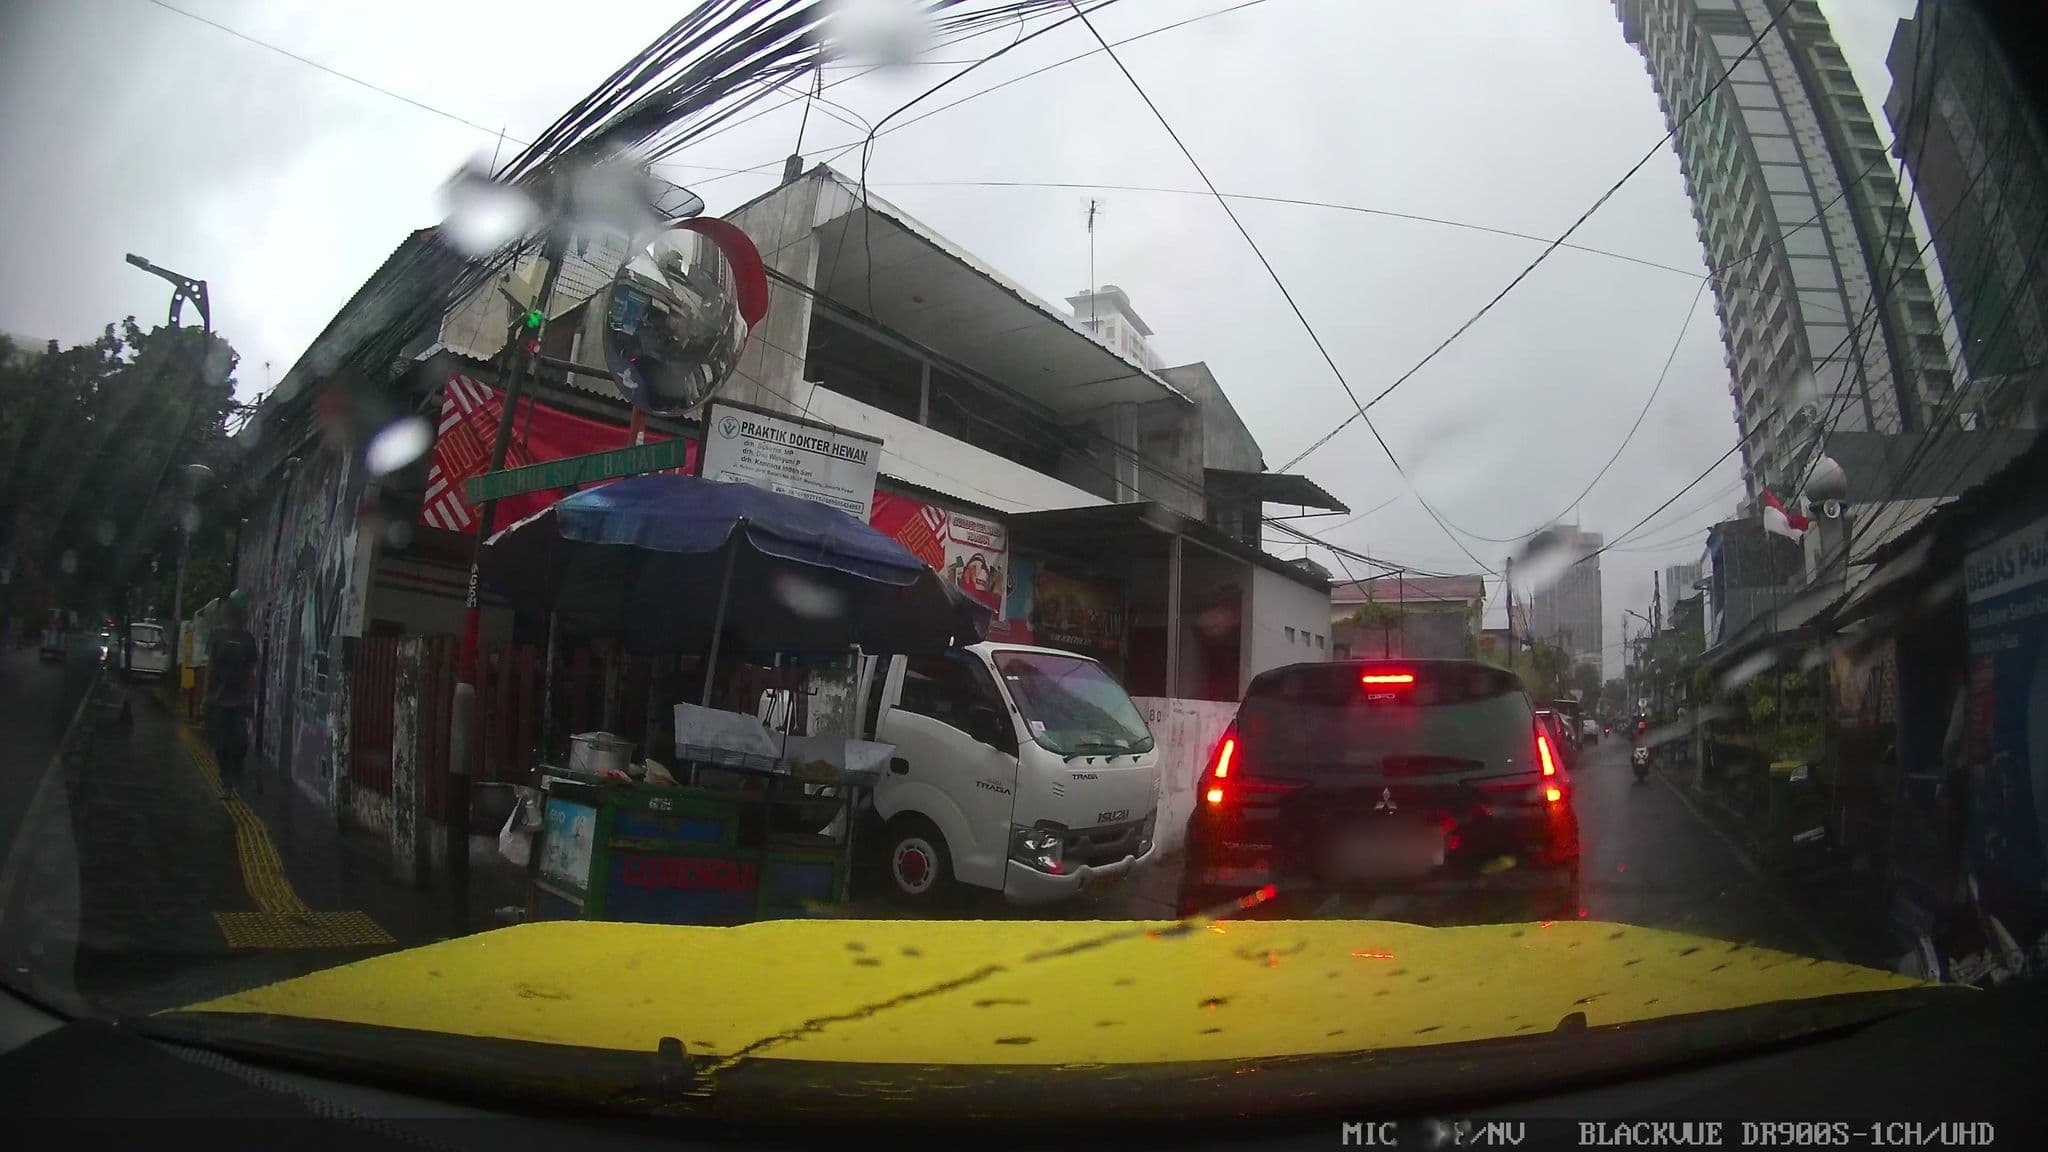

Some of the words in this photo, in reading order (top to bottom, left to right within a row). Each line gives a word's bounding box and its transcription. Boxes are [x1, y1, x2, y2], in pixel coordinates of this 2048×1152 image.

[741, 421, 787, 444] PRAKTIK
[789, 433, 831, 453] DOKTER
[832, 443, 869, 463] HEWAN
[602, 447, 656, 477] BARAT
[1967, 548, 2015, 593] BEBAS
[975, 780, 1011, 796] TRAGA
[1072, 773, 1098, 781] TRAGA
[1097, 808, 1129, 824] ISUZU
